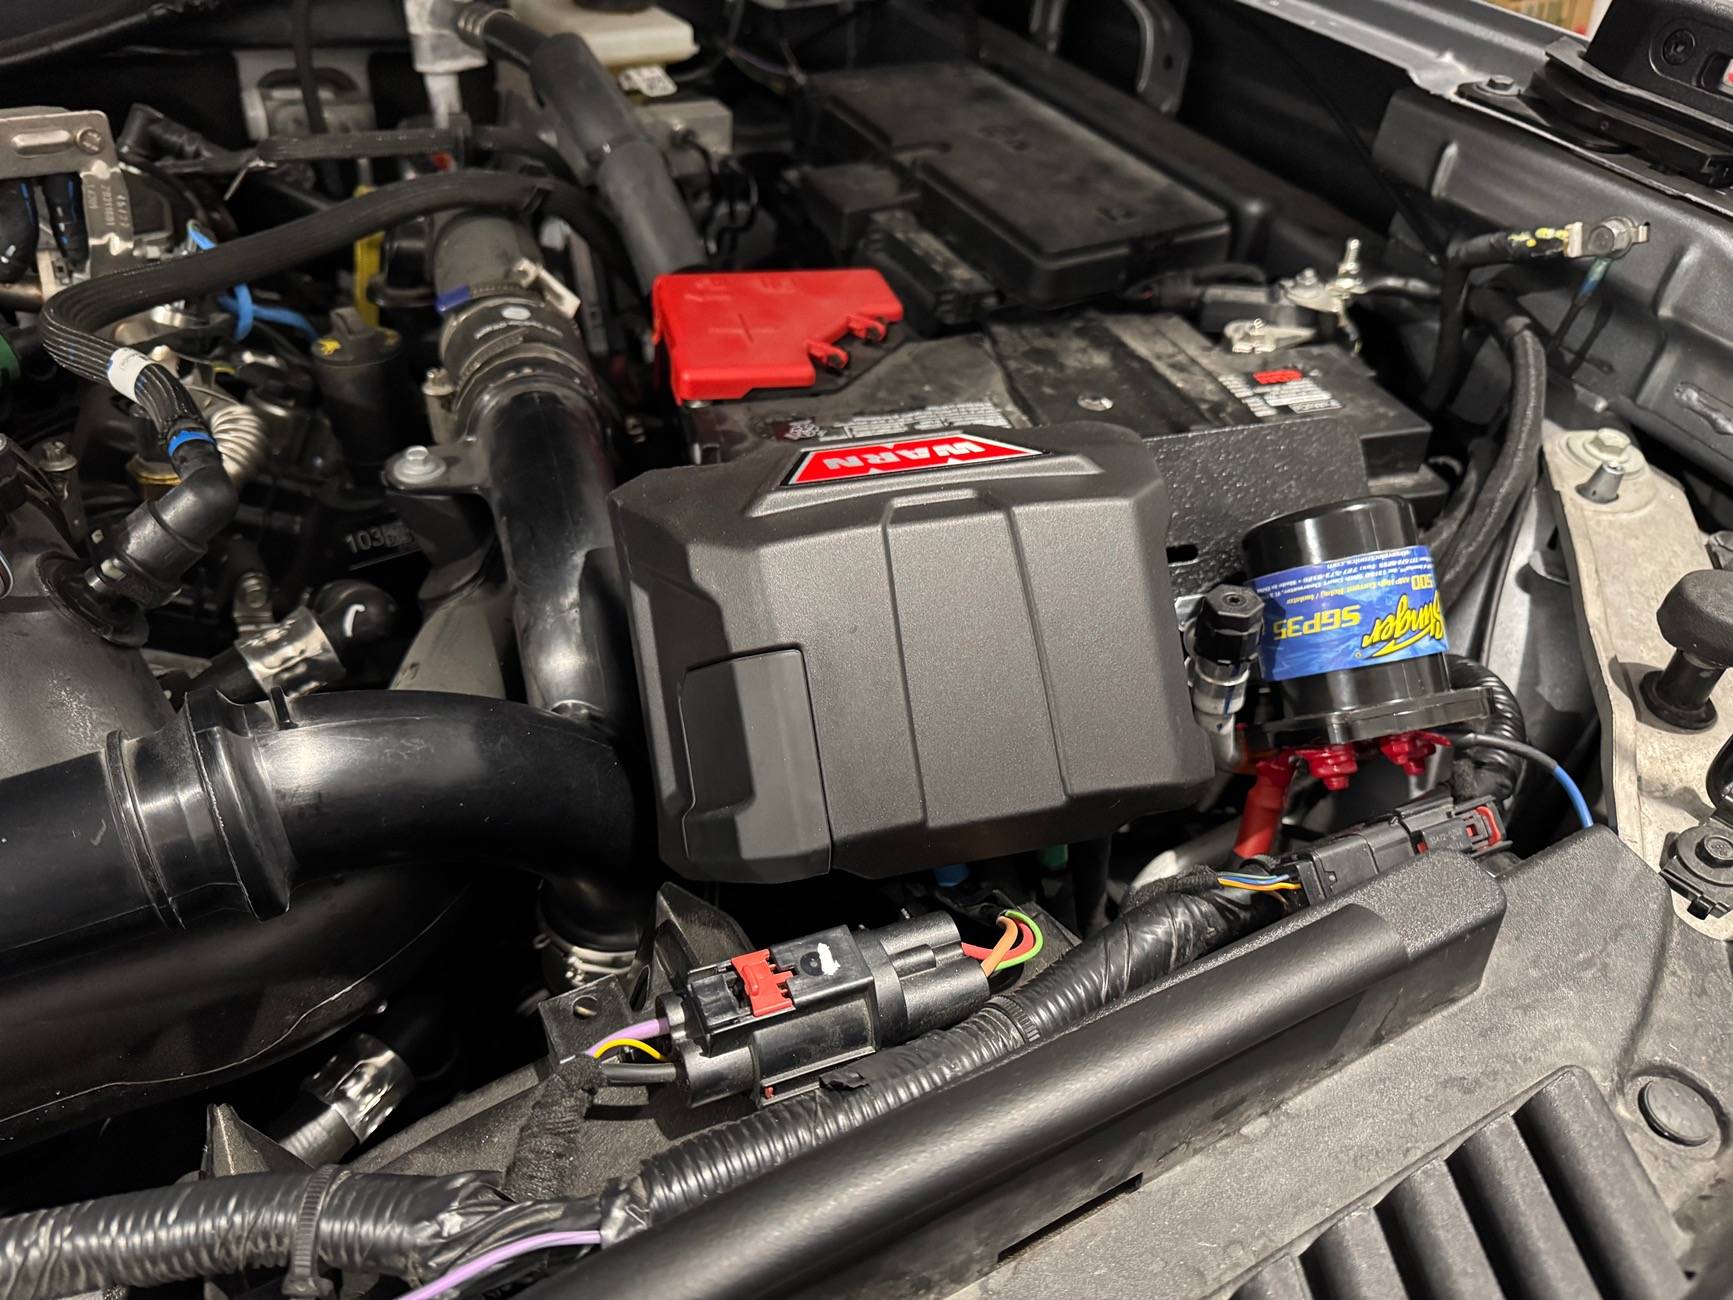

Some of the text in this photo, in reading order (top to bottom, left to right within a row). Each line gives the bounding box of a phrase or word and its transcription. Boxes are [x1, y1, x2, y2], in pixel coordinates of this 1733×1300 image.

[822, 442, 985, 470] WARN
[1411, 574, 1434, 590] 500
[1273, 605, 1360, 640] SGP35
[1361, 590, 1443, 660] Stinger
